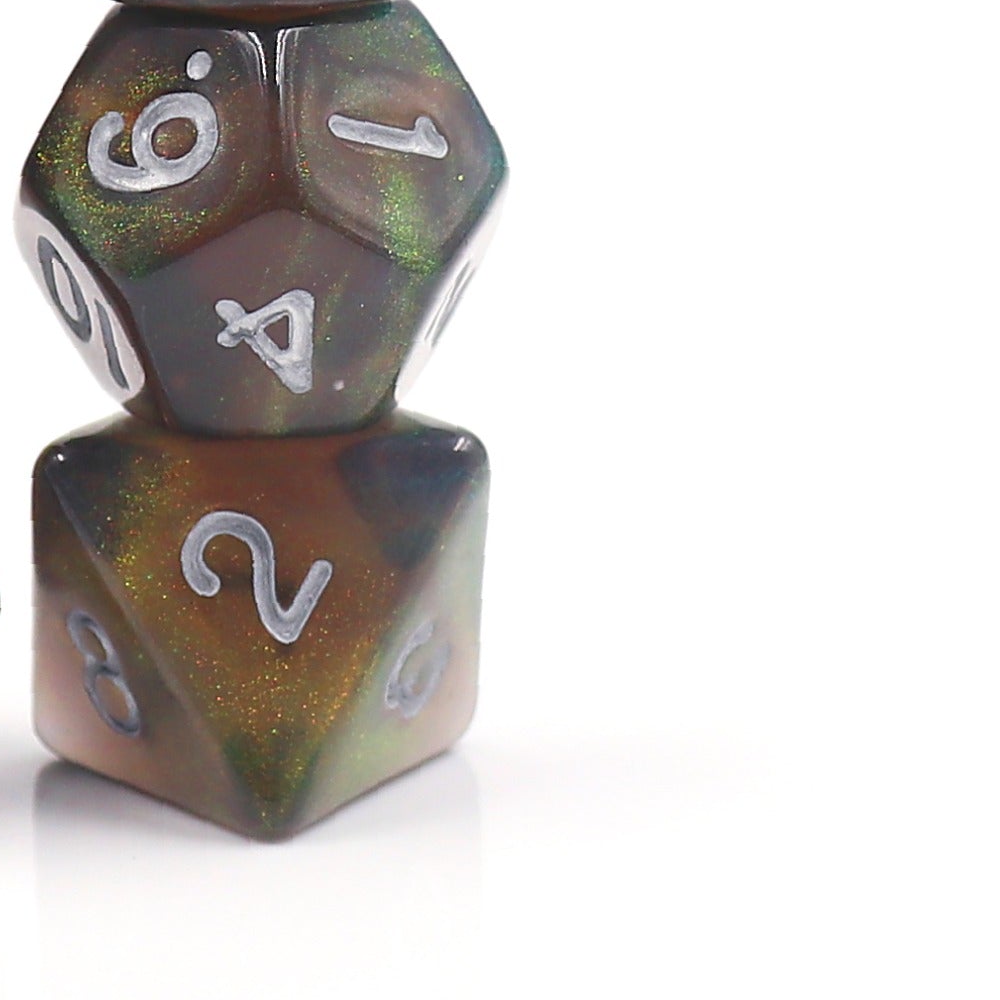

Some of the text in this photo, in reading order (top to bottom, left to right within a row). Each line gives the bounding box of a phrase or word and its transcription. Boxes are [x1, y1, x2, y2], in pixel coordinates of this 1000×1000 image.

[328, 112, 449, 159] 1
[214, 289, 315, 394] 4
[180, 510, 333, 645] 2
[66, 610, 141, 736] 8
